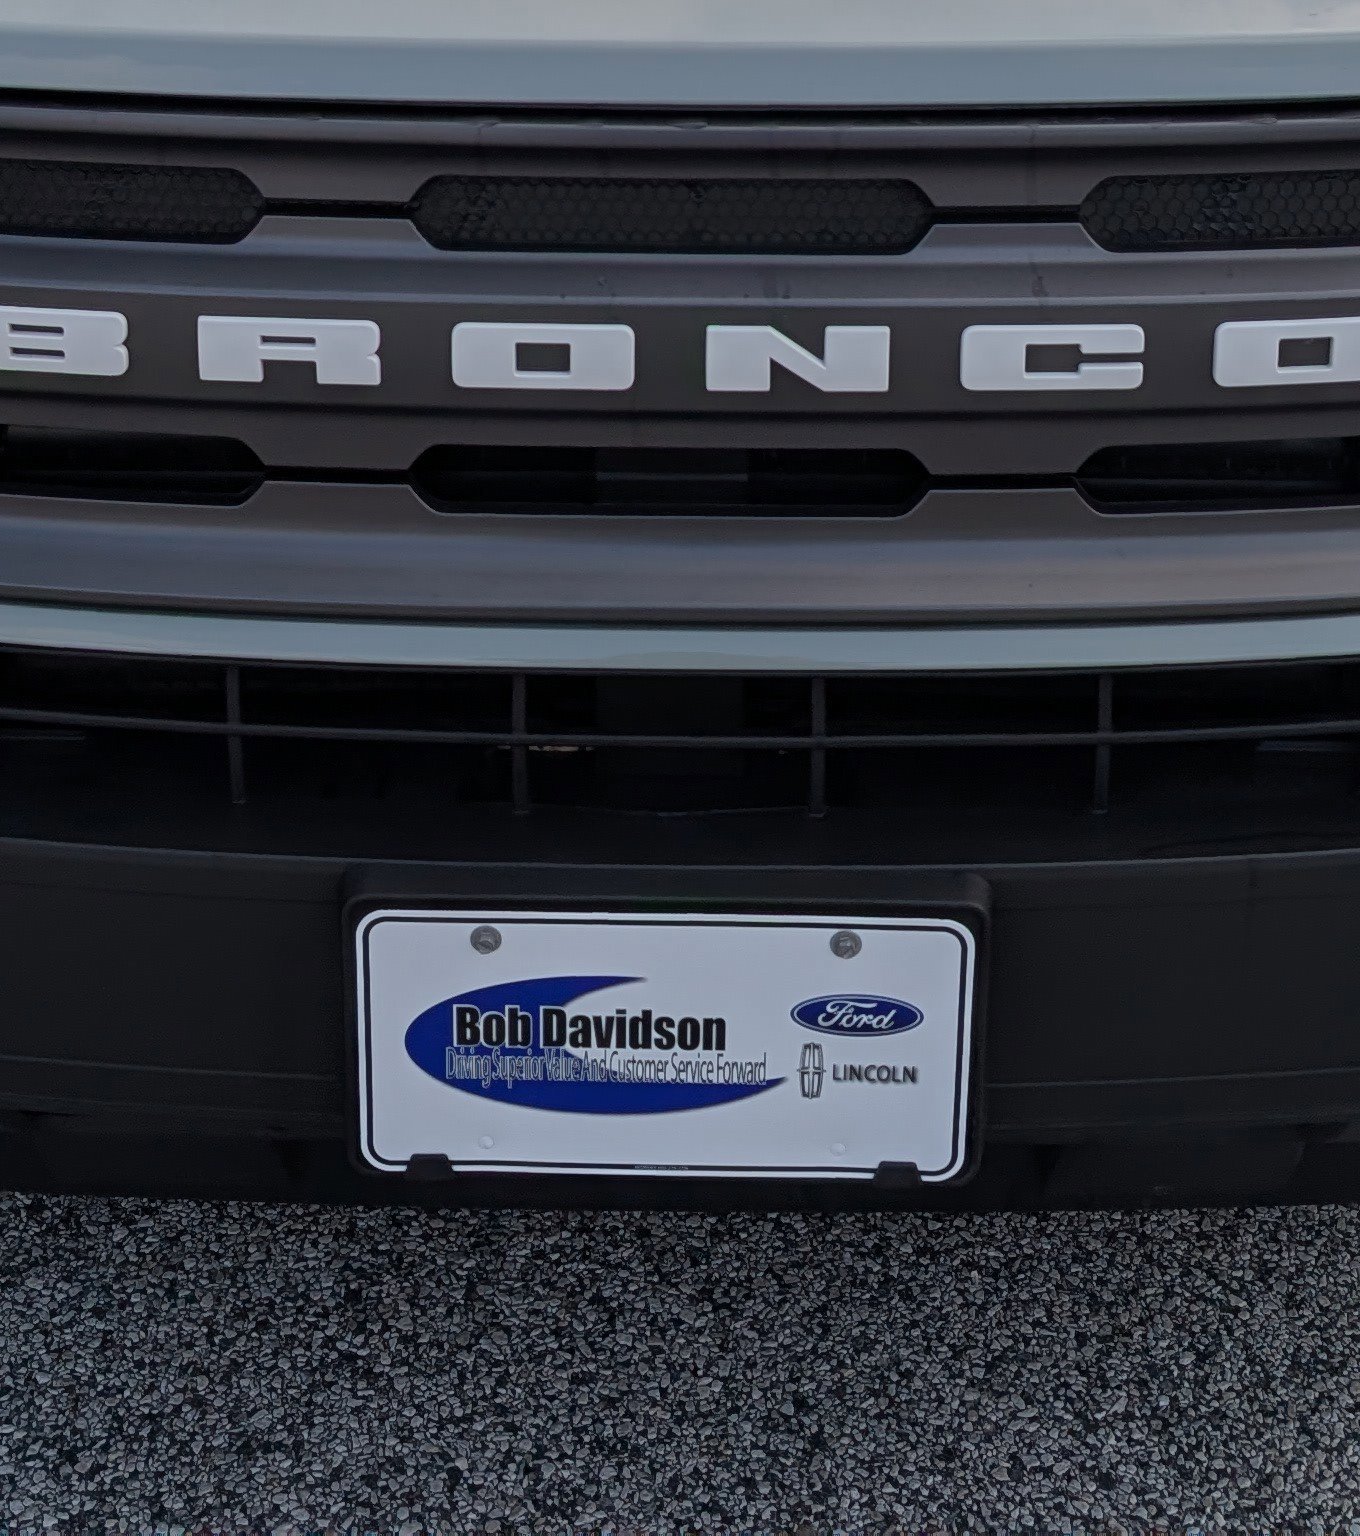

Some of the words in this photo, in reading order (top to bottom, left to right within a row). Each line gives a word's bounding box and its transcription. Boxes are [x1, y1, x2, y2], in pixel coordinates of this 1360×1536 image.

[452, 1003, 534, 1048] Bob
[541, 1004, 727, 1052] Davidson
[817, 1000, 898, 1030] Ford
[445, 1047, 491, 1088] Driving
[492, 1048, 544, 1088] Superior
[543, 1048, 580, 1082] Value
[580, 1050, 609, 1082] And
[609, 1050, 671, 1084] Customer
[671, 1052, 713, 1084] Service
[717, 1051, 768, 1086] Forward
[832, 1063, 918, 1084] LINCOLN
